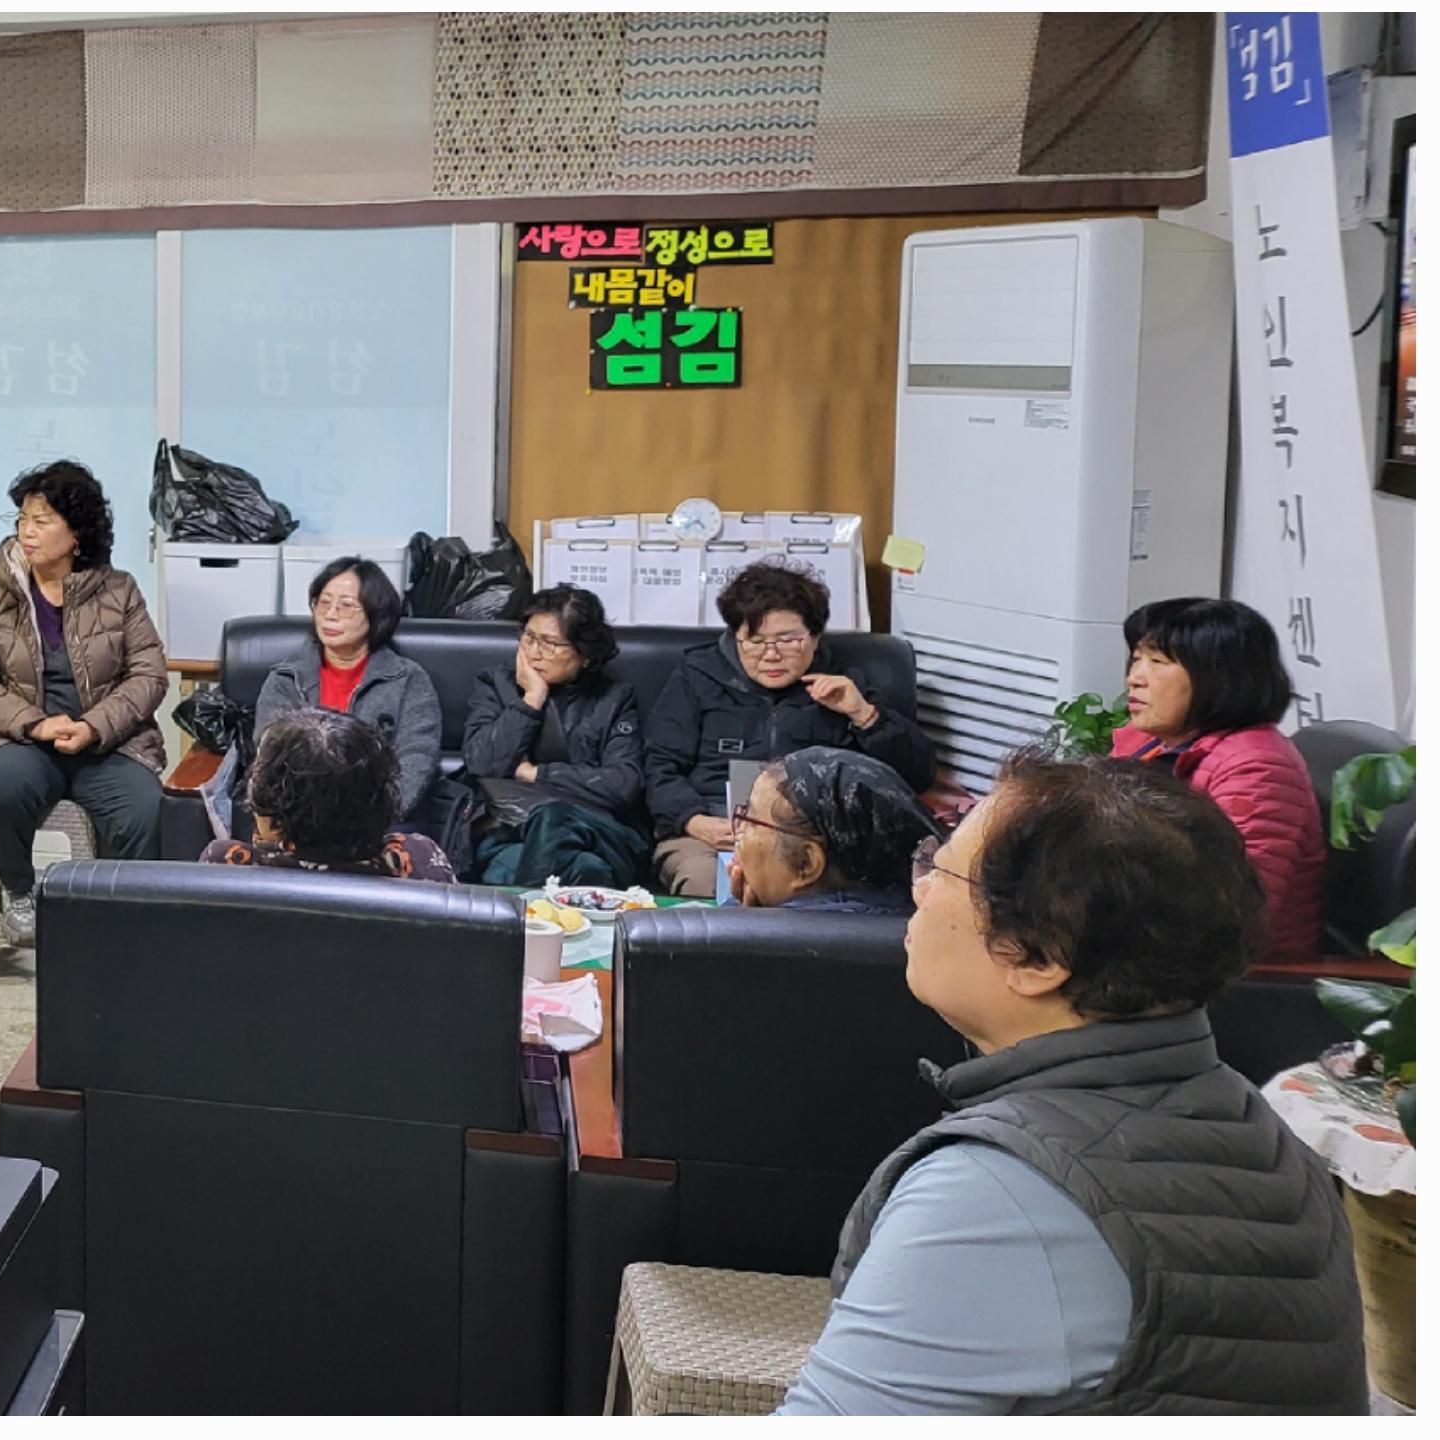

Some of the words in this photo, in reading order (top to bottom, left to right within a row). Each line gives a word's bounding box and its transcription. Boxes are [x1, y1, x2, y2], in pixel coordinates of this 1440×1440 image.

[518, 224, 642, 260] 사랑으로
[645, 226, 774, 266] 정성으로
[573, 268, 696, 306] 내몸같이
[596, 310, 740, 385] 섬김
